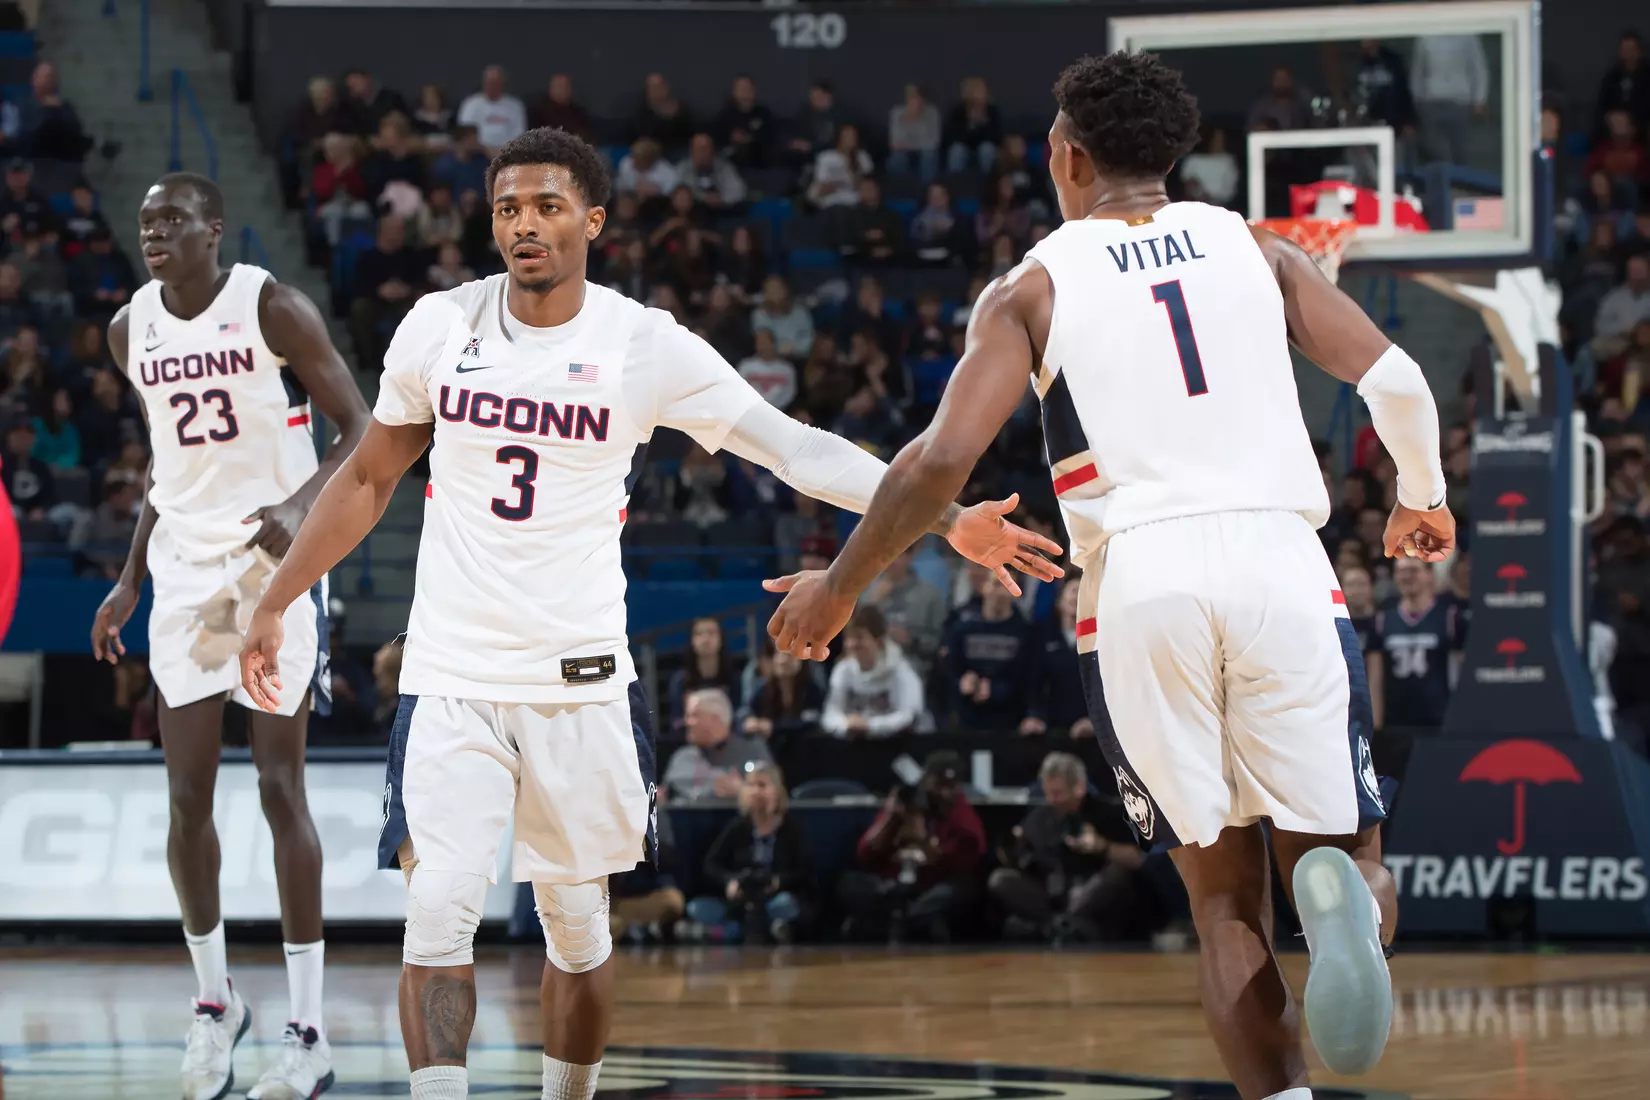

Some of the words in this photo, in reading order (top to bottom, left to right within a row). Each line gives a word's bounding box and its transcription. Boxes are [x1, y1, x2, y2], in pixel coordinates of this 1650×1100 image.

[769, 12, 847, 49] 120
[1106, 229, 1205, 273] VITAL
[140, 346, 254, 387] UCONN
[1150, 279, 1208, 397] 1
[168, 388, 240, 447] 23
[439, 384, 610, 442] UCONN
[490, 444, 539, 522] 3
